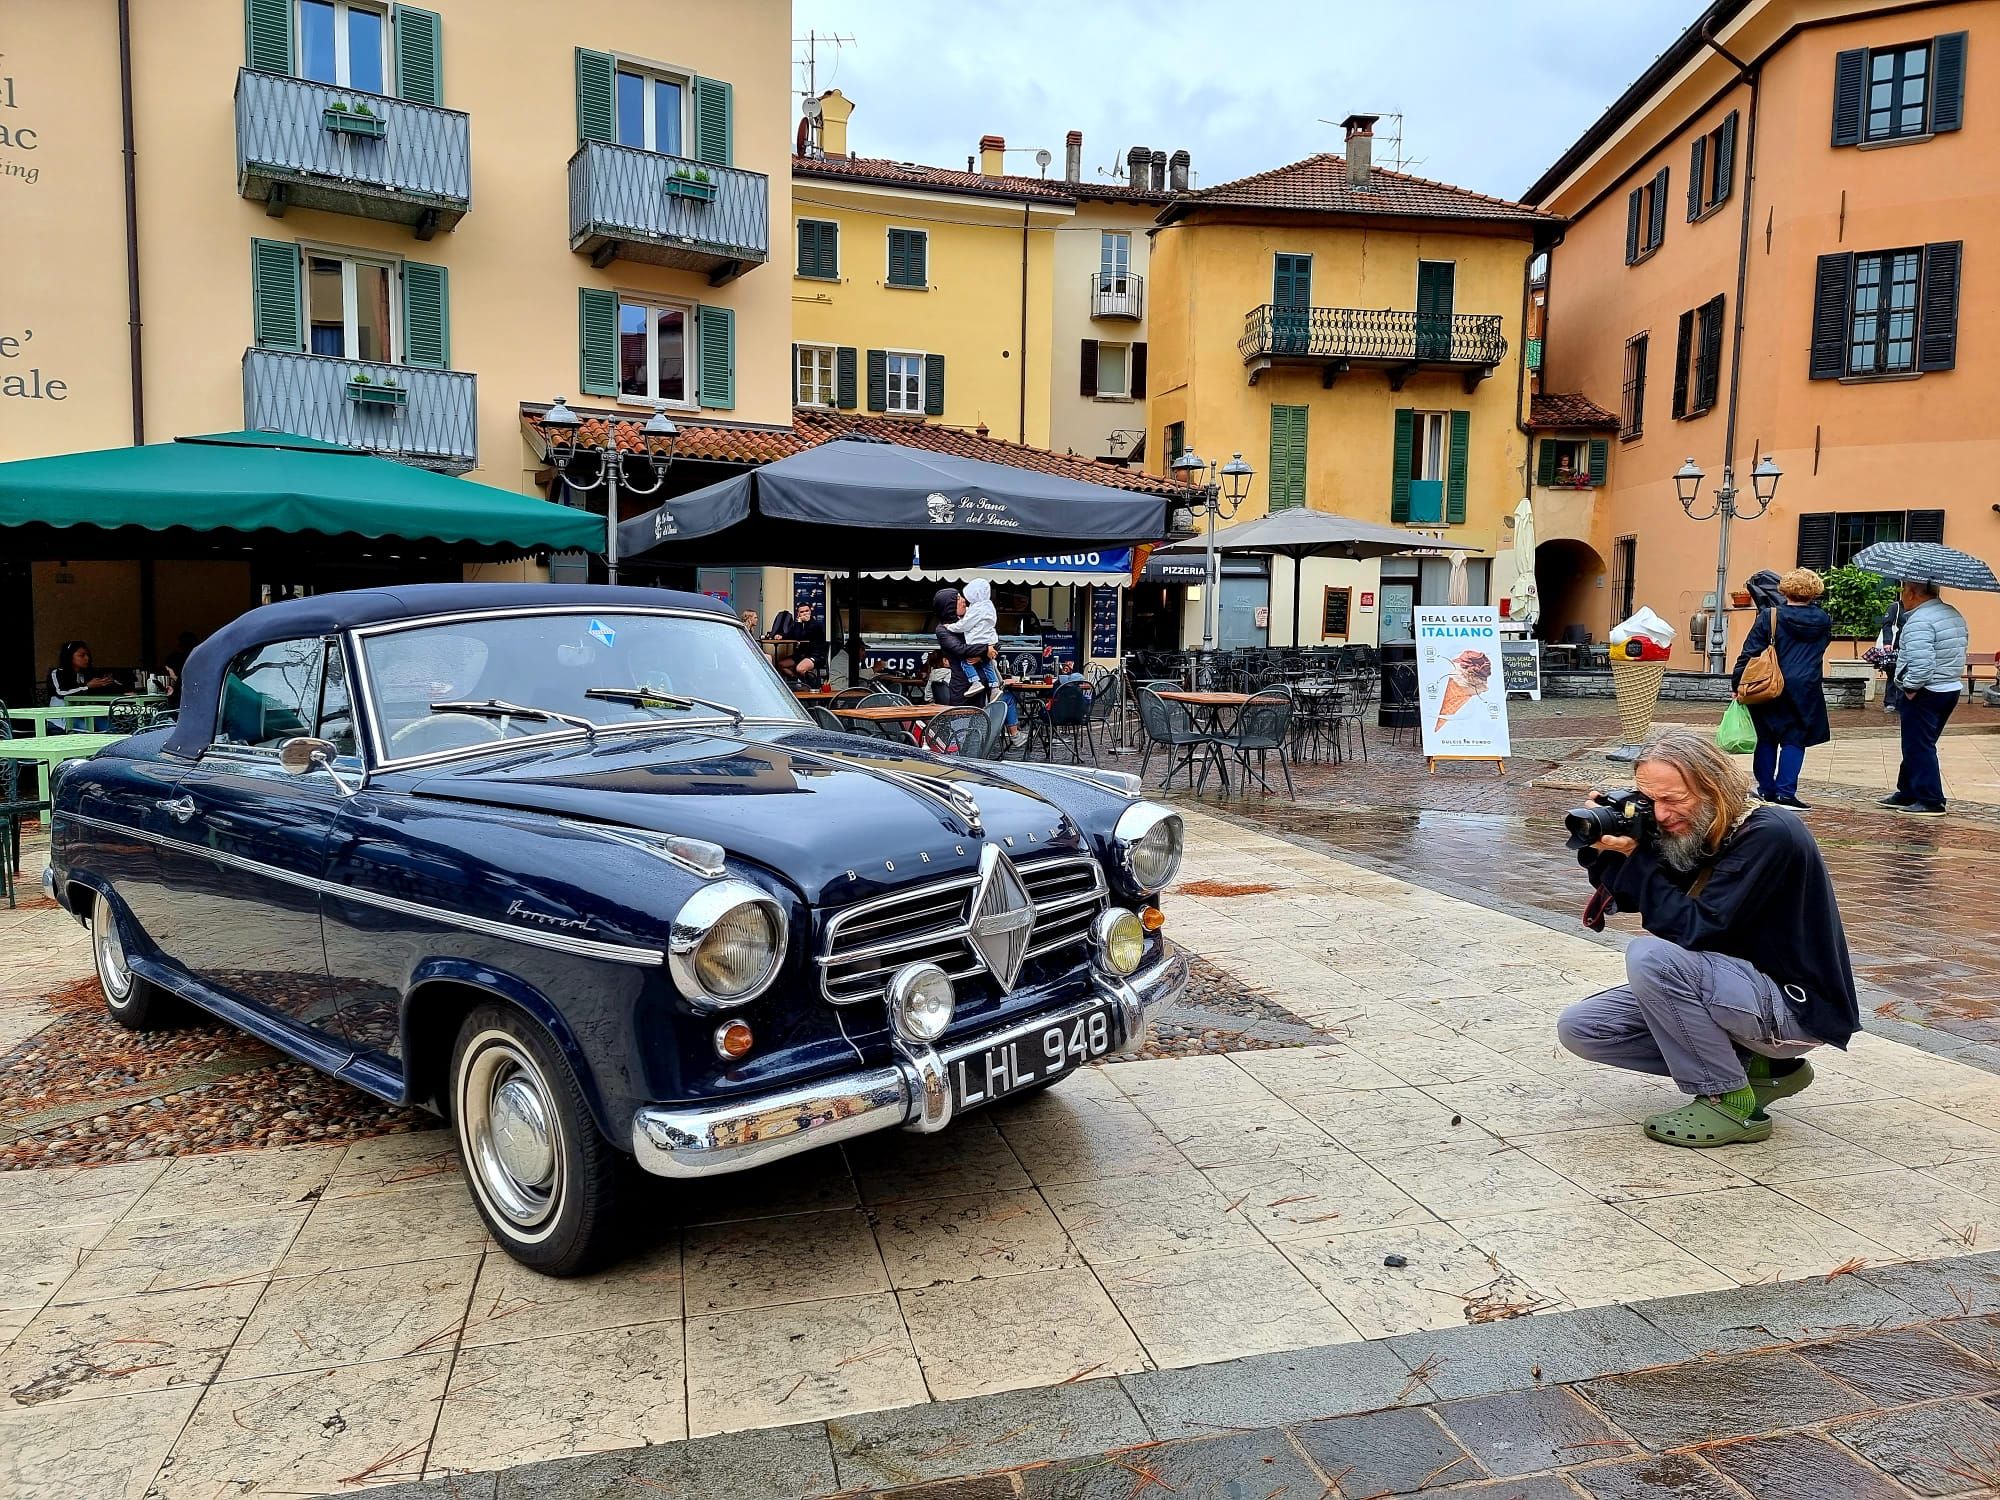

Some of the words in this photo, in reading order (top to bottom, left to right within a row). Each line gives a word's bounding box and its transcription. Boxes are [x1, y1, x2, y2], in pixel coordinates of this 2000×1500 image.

[0, 158, 39, 184] ing
[0, 368, 67, 401] ale
[958, 496, 975, 509] La
[977, 497, 1008, 512] Tana
[966, 511, 984, 524] del
[985, 513, 1020, 527] Luccio
[1162, 566, 1206, 576] PIZZERIA
[1421, 615, 1447, 623] REAL
[1451, 615, 1493, 623] GELATO
[1422, 627, 1494, 638] ITALIANO
[958, 1042, 1035, 1108] LHL
[1043, 1011, 1109, 1075] 948
